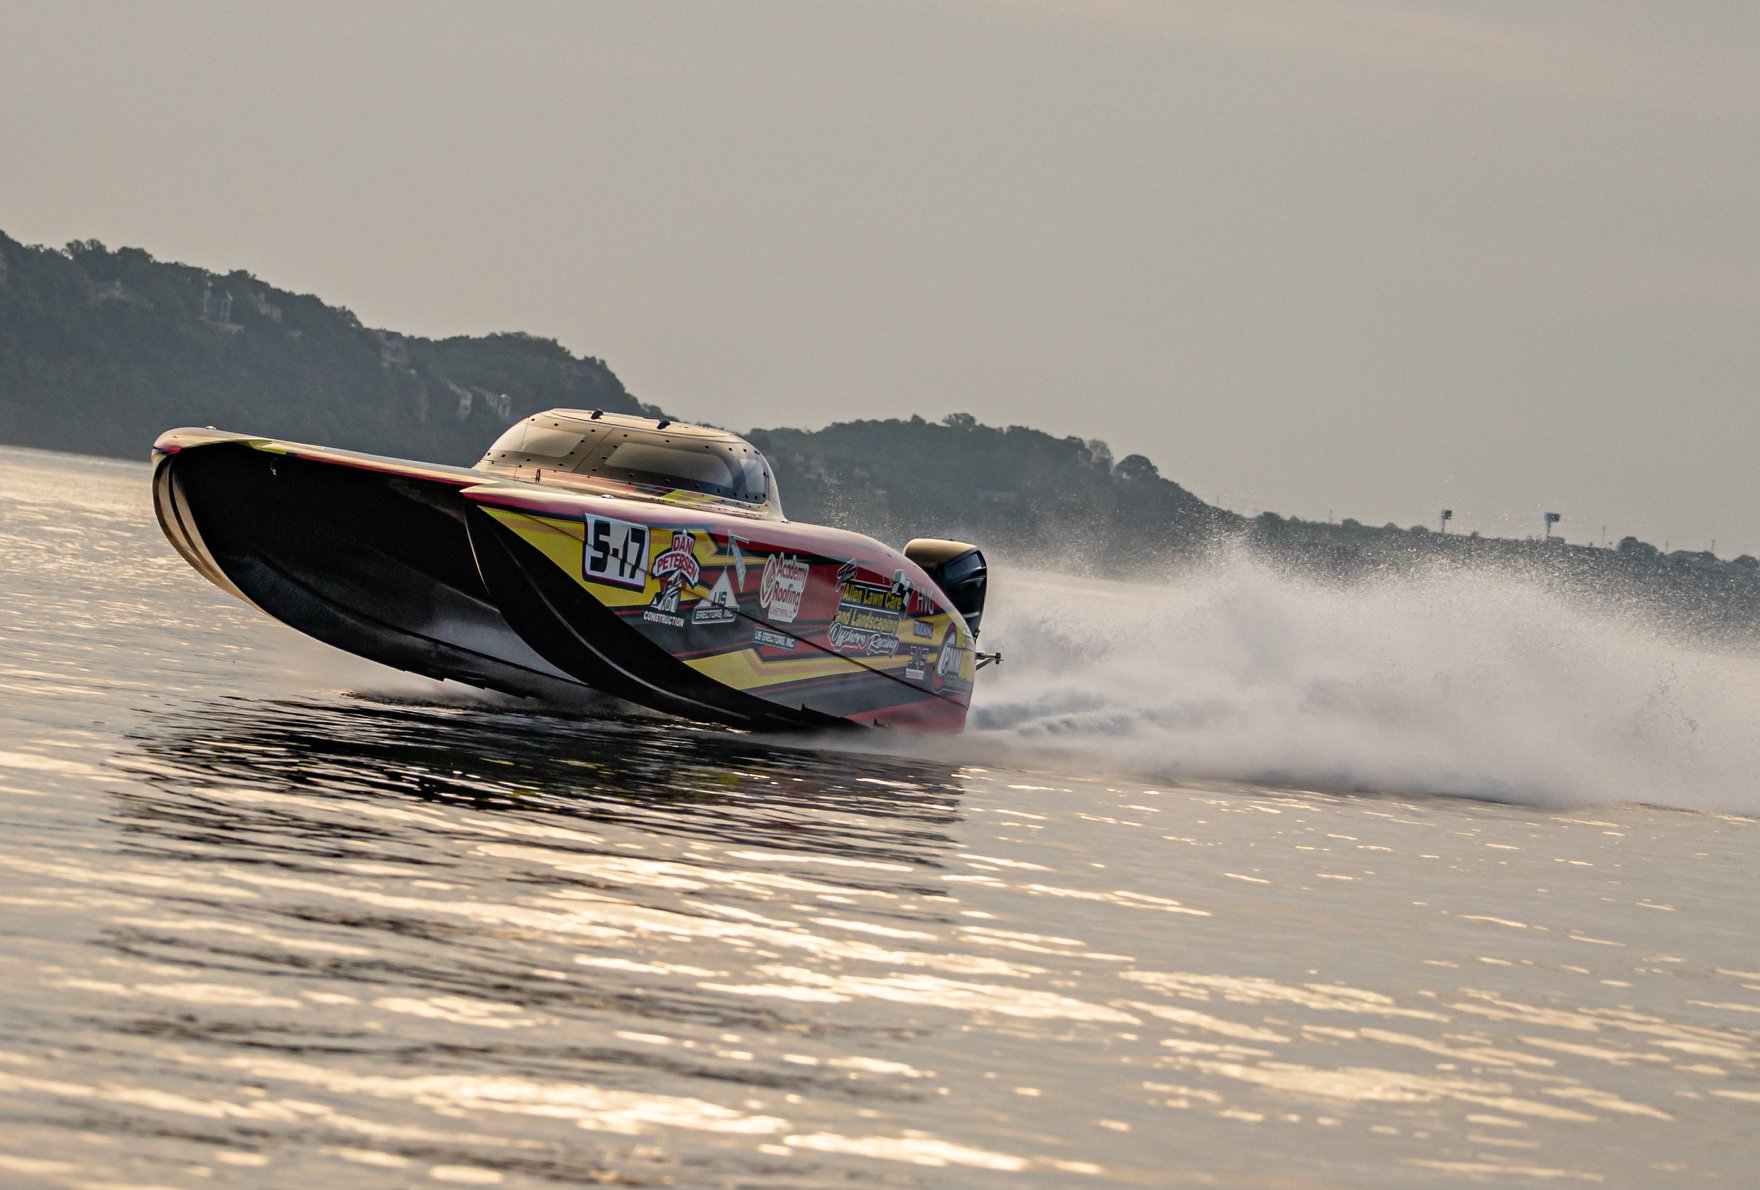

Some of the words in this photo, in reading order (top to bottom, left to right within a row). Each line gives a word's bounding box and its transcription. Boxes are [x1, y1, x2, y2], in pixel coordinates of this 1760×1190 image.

[673, 536, 693, 555] DAN
[657, 553, 698, 579] PETERSEN
[777, 556, 807, 588] Academy
[711, 591, 727, 607] US
[774, 581, 801, 612] Roofing
[842, 583, 862, 603] Allen
[863, 587, 883, 607] Lawn
[885, 590, 903, 610] Care
[643, 610, 684, 627] CONSTRUCTION
[835, 608, 852, 624] and
[851, 608, 899, 637] Landscaping
[754, 630, 761, 641] US
[829, 623, 866, 648] Offshore
[869, 633, 898, 657] Racing
